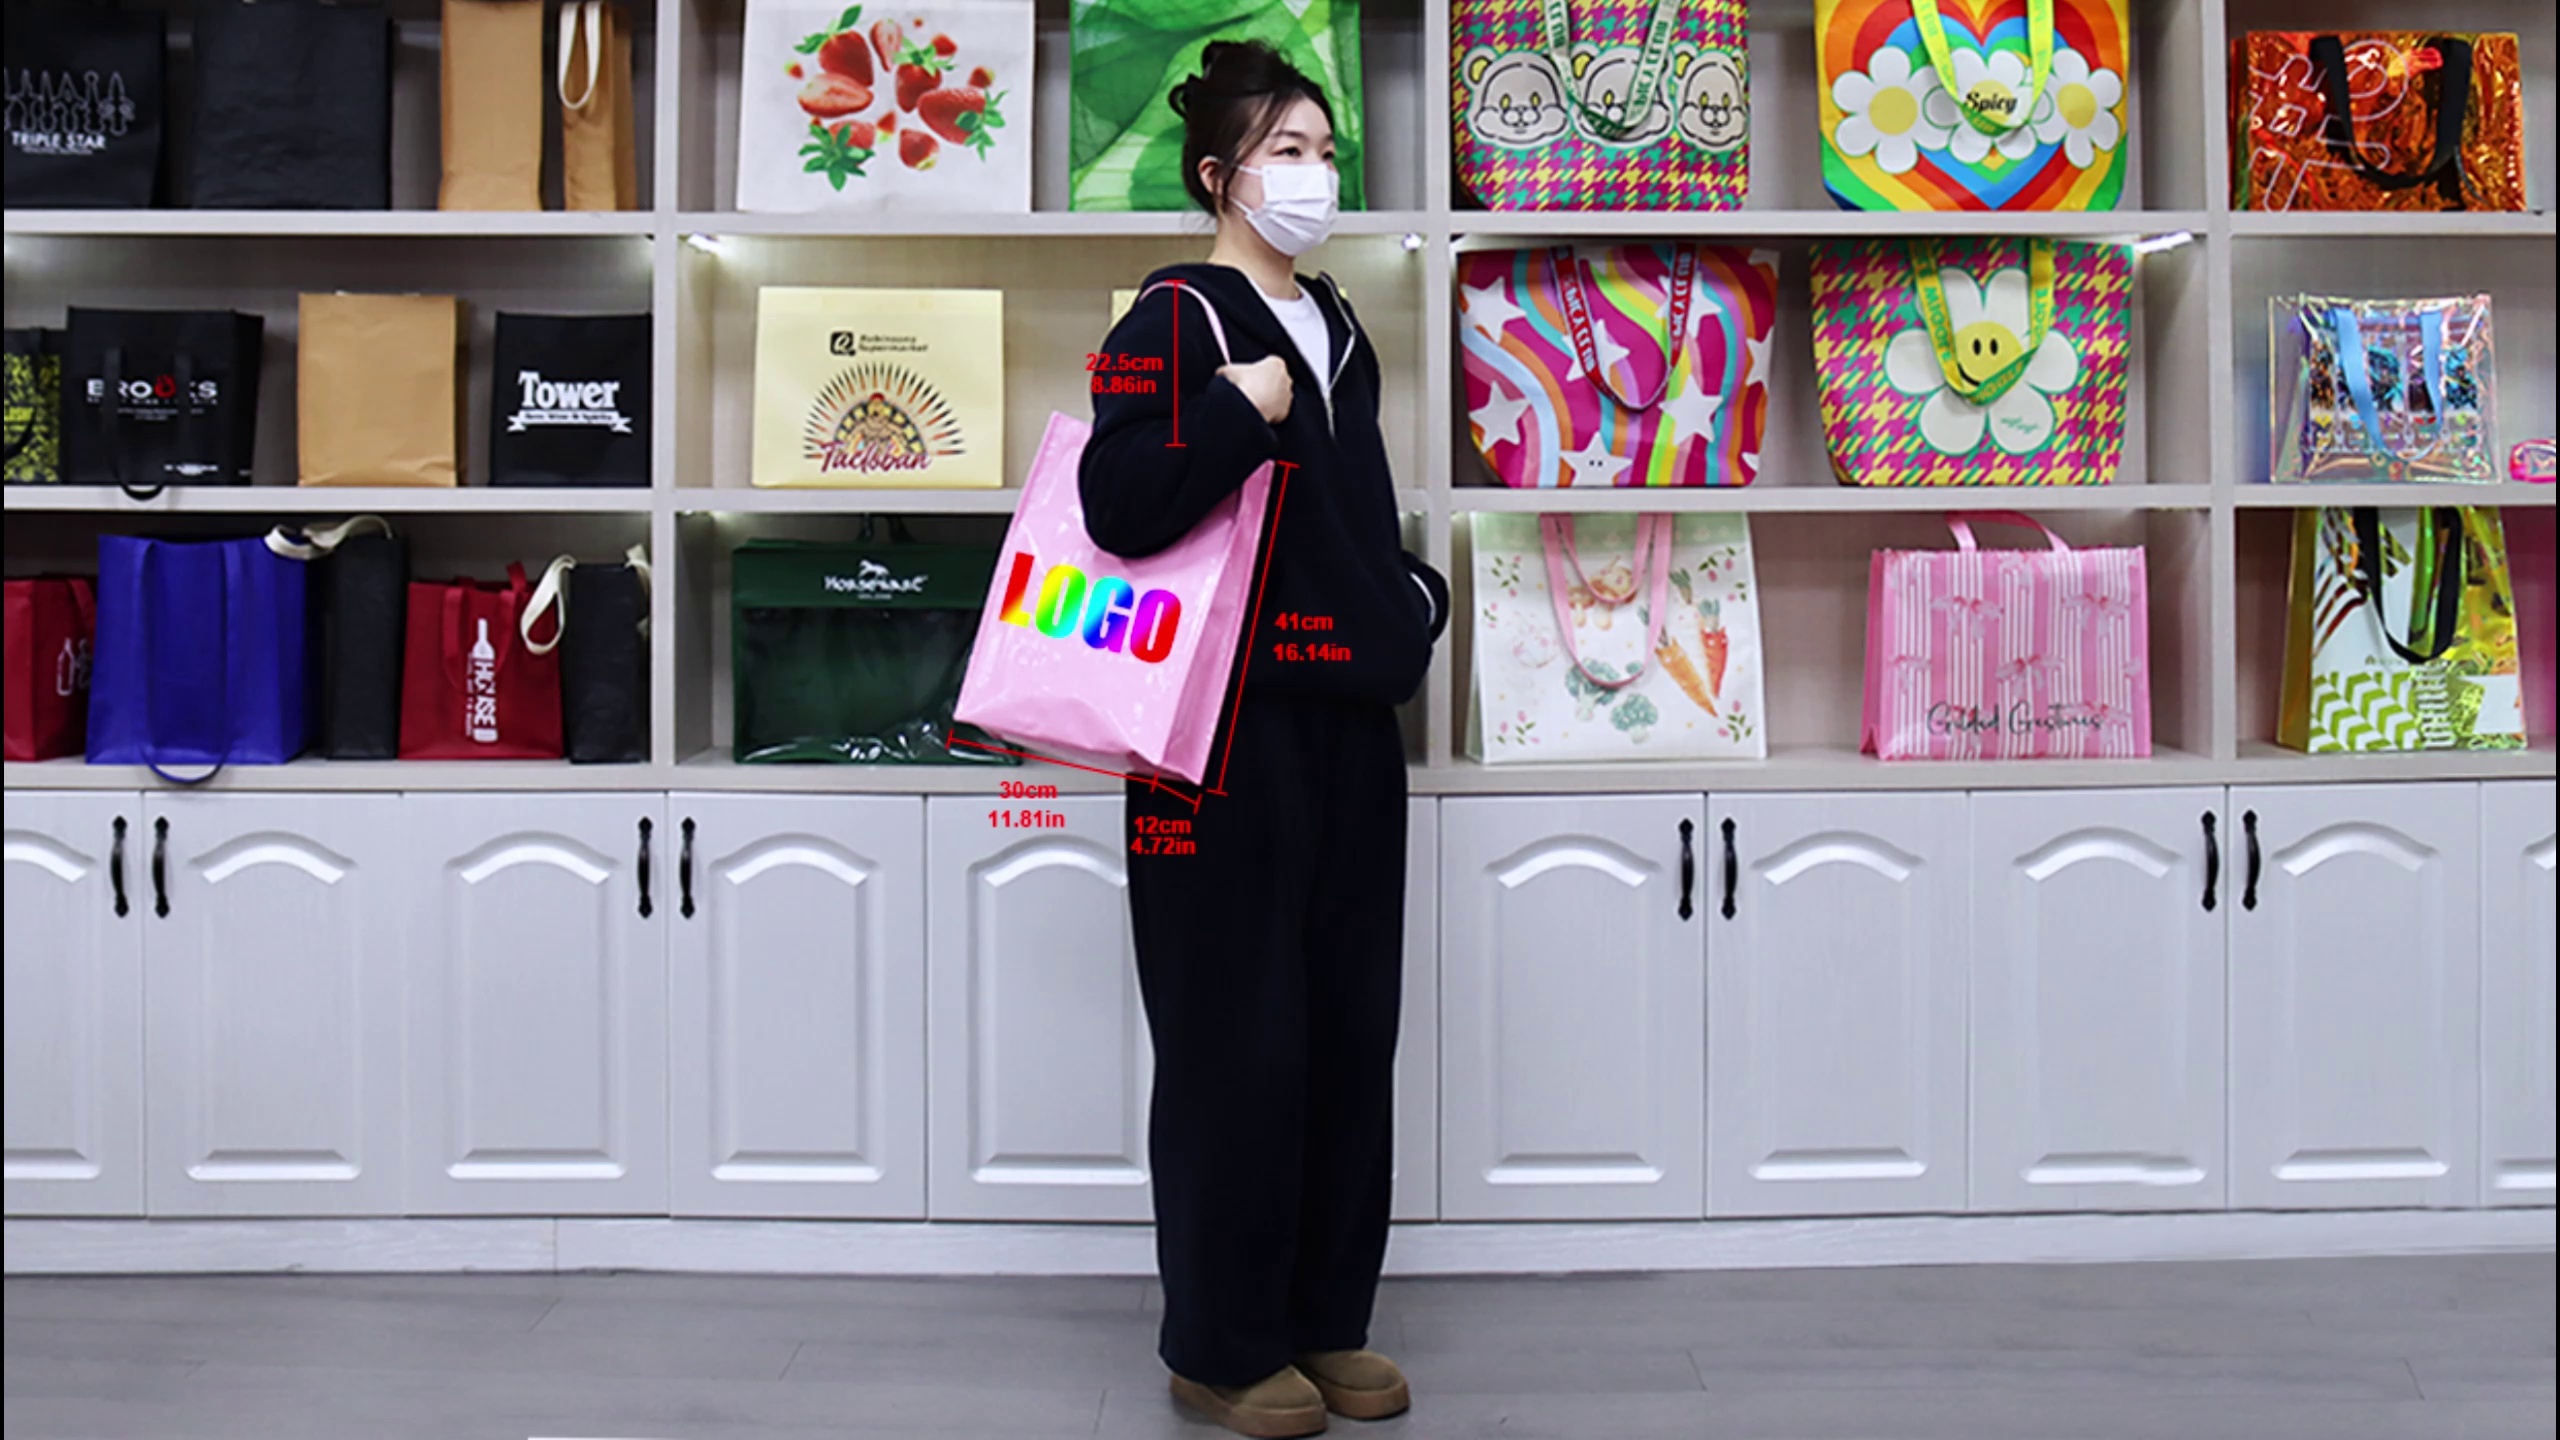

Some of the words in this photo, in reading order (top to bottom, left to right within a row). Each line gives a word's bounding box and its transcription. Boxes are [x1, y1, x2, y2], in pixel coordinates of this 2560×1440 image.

[1964, 92, 2018, 114] Spicy
[12, 131, 60, 147] TRIPLE
[66, 133, 106, 150] STAR
[87, 374, 218, 399] BROOS
[518, 370, 620, 409] Tower
[820, 439, 930, 474] Tacloban
[999, 552, 1182, 663] LOGO
